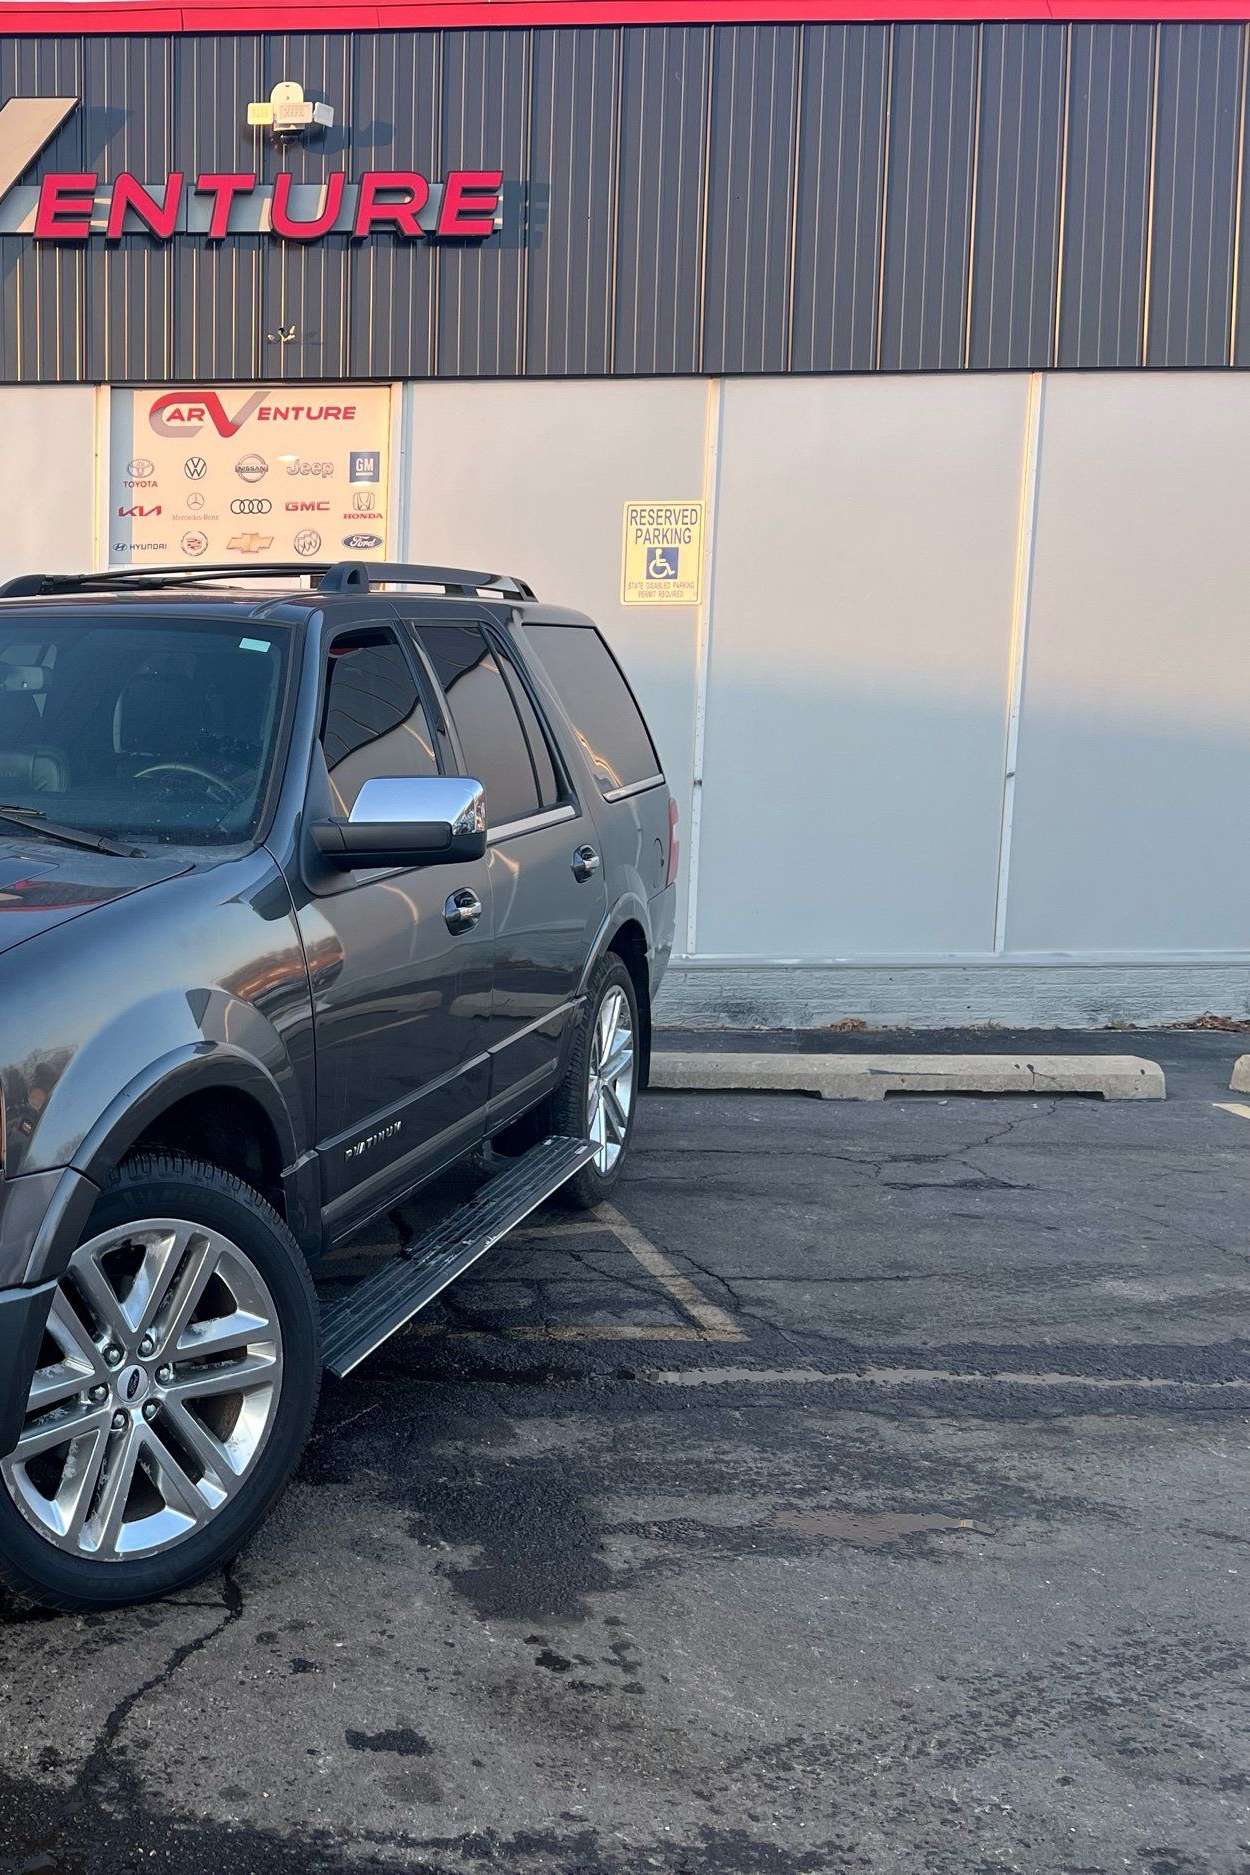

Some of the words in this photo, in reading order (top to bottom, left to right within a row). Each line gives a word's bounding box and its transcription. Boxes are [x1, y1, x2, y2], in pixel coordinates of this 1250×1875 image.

[286, 459, 334, 478] Jeep
[355, 458, 374, 472] GM
[118, 505, 162, 517] KIA
[285, 501, 330, 512] GMC
[630, 508, 698, 526] RESERVED
[350, 535, 376, 547] Ford
[635, 527, 692, 545] PARKING
[129, 543, 167, 551] HYUNDAI
[672, 581, 695, 589] PARKING
[344, 1120, 402, 1162] PLATINUM
